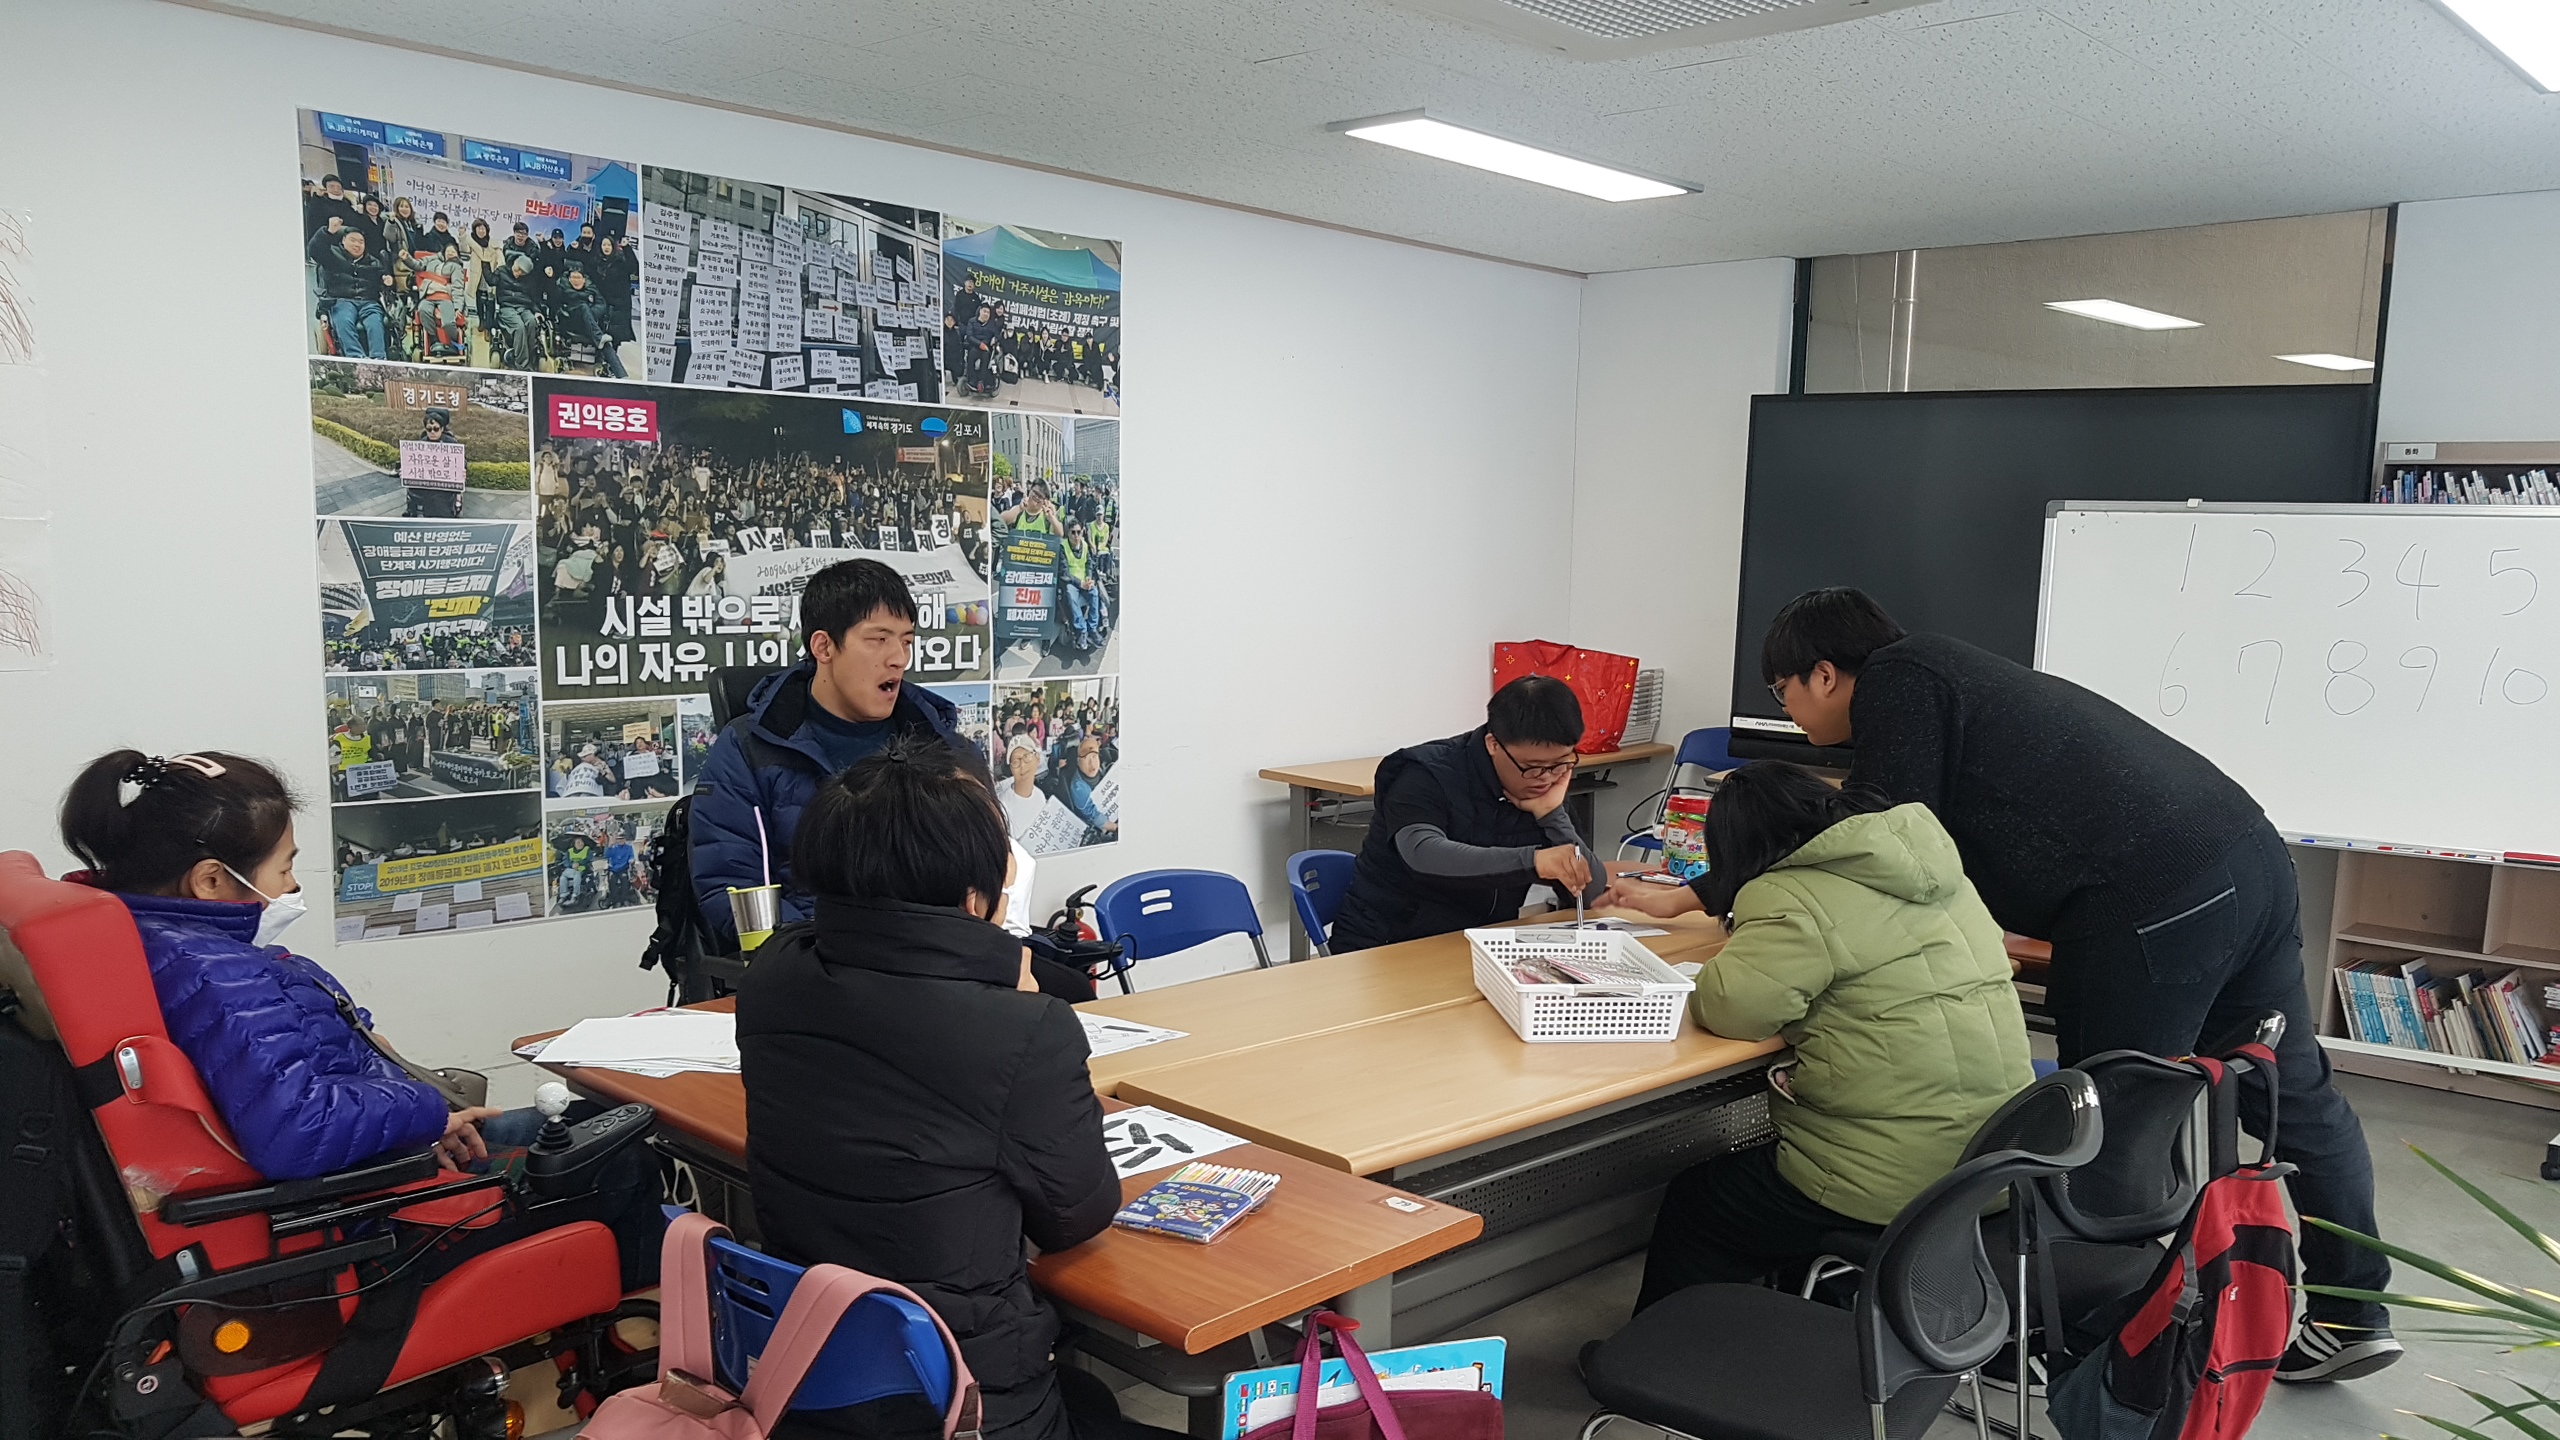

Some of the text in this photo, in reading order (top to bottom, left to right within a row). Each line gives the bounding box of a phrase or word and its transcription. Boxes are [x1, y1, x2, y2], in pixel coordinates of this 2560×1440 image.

[438, 185, 480, 202] 국무총리
[442, 203, 500, 221] 더불어민주당
[525, 198, 580, 221] 만납시다!
[1009, 281, 1058, 304] 거주시설은
[1073, 313, 1089, 326] 제정
[403, 387, 460, 407] 경기도청
[557, 401, 649, 434] 권익옹호
[890, 423, 914, 435] 경기도
[953, 423, 982, 438] 김포시
[408, 453, 440, 468] 자유로운
[408, 467, 452, 480] 시설 밖으로
[394, 530, 472, 544] 예산 반영없는
[746, 530, 766, 551] 시
[769, 532, 785, 552] 설
[881, 530, 897, 551] 법
[917, 533, 934, 551] 제
[935, 518, 950, 539] 정
[362, 543, 499, 558] 장애등급제 단계적 폐지는
[380, 556, 486, 571] 단계적 사기행각이다!
[757, 562, 801, 578] 20090604
[2180, 523, 2538, 620] 1 2 3 4 5
[1005, 570, 1054, 585] 장애등급제
[375, 574, 493, 600] 장애등급제
[1015, 588, 1042, 605] 진짜
[599, 593, 946, 637] 시설 밖으로 해
[556, 643, 629, 686] 나의
[2158, 632, 2548, 725] 6 7 8 9 10
[347, 882, 374, 892] STOP!
[379, 873, 417, 888] 2019년을
